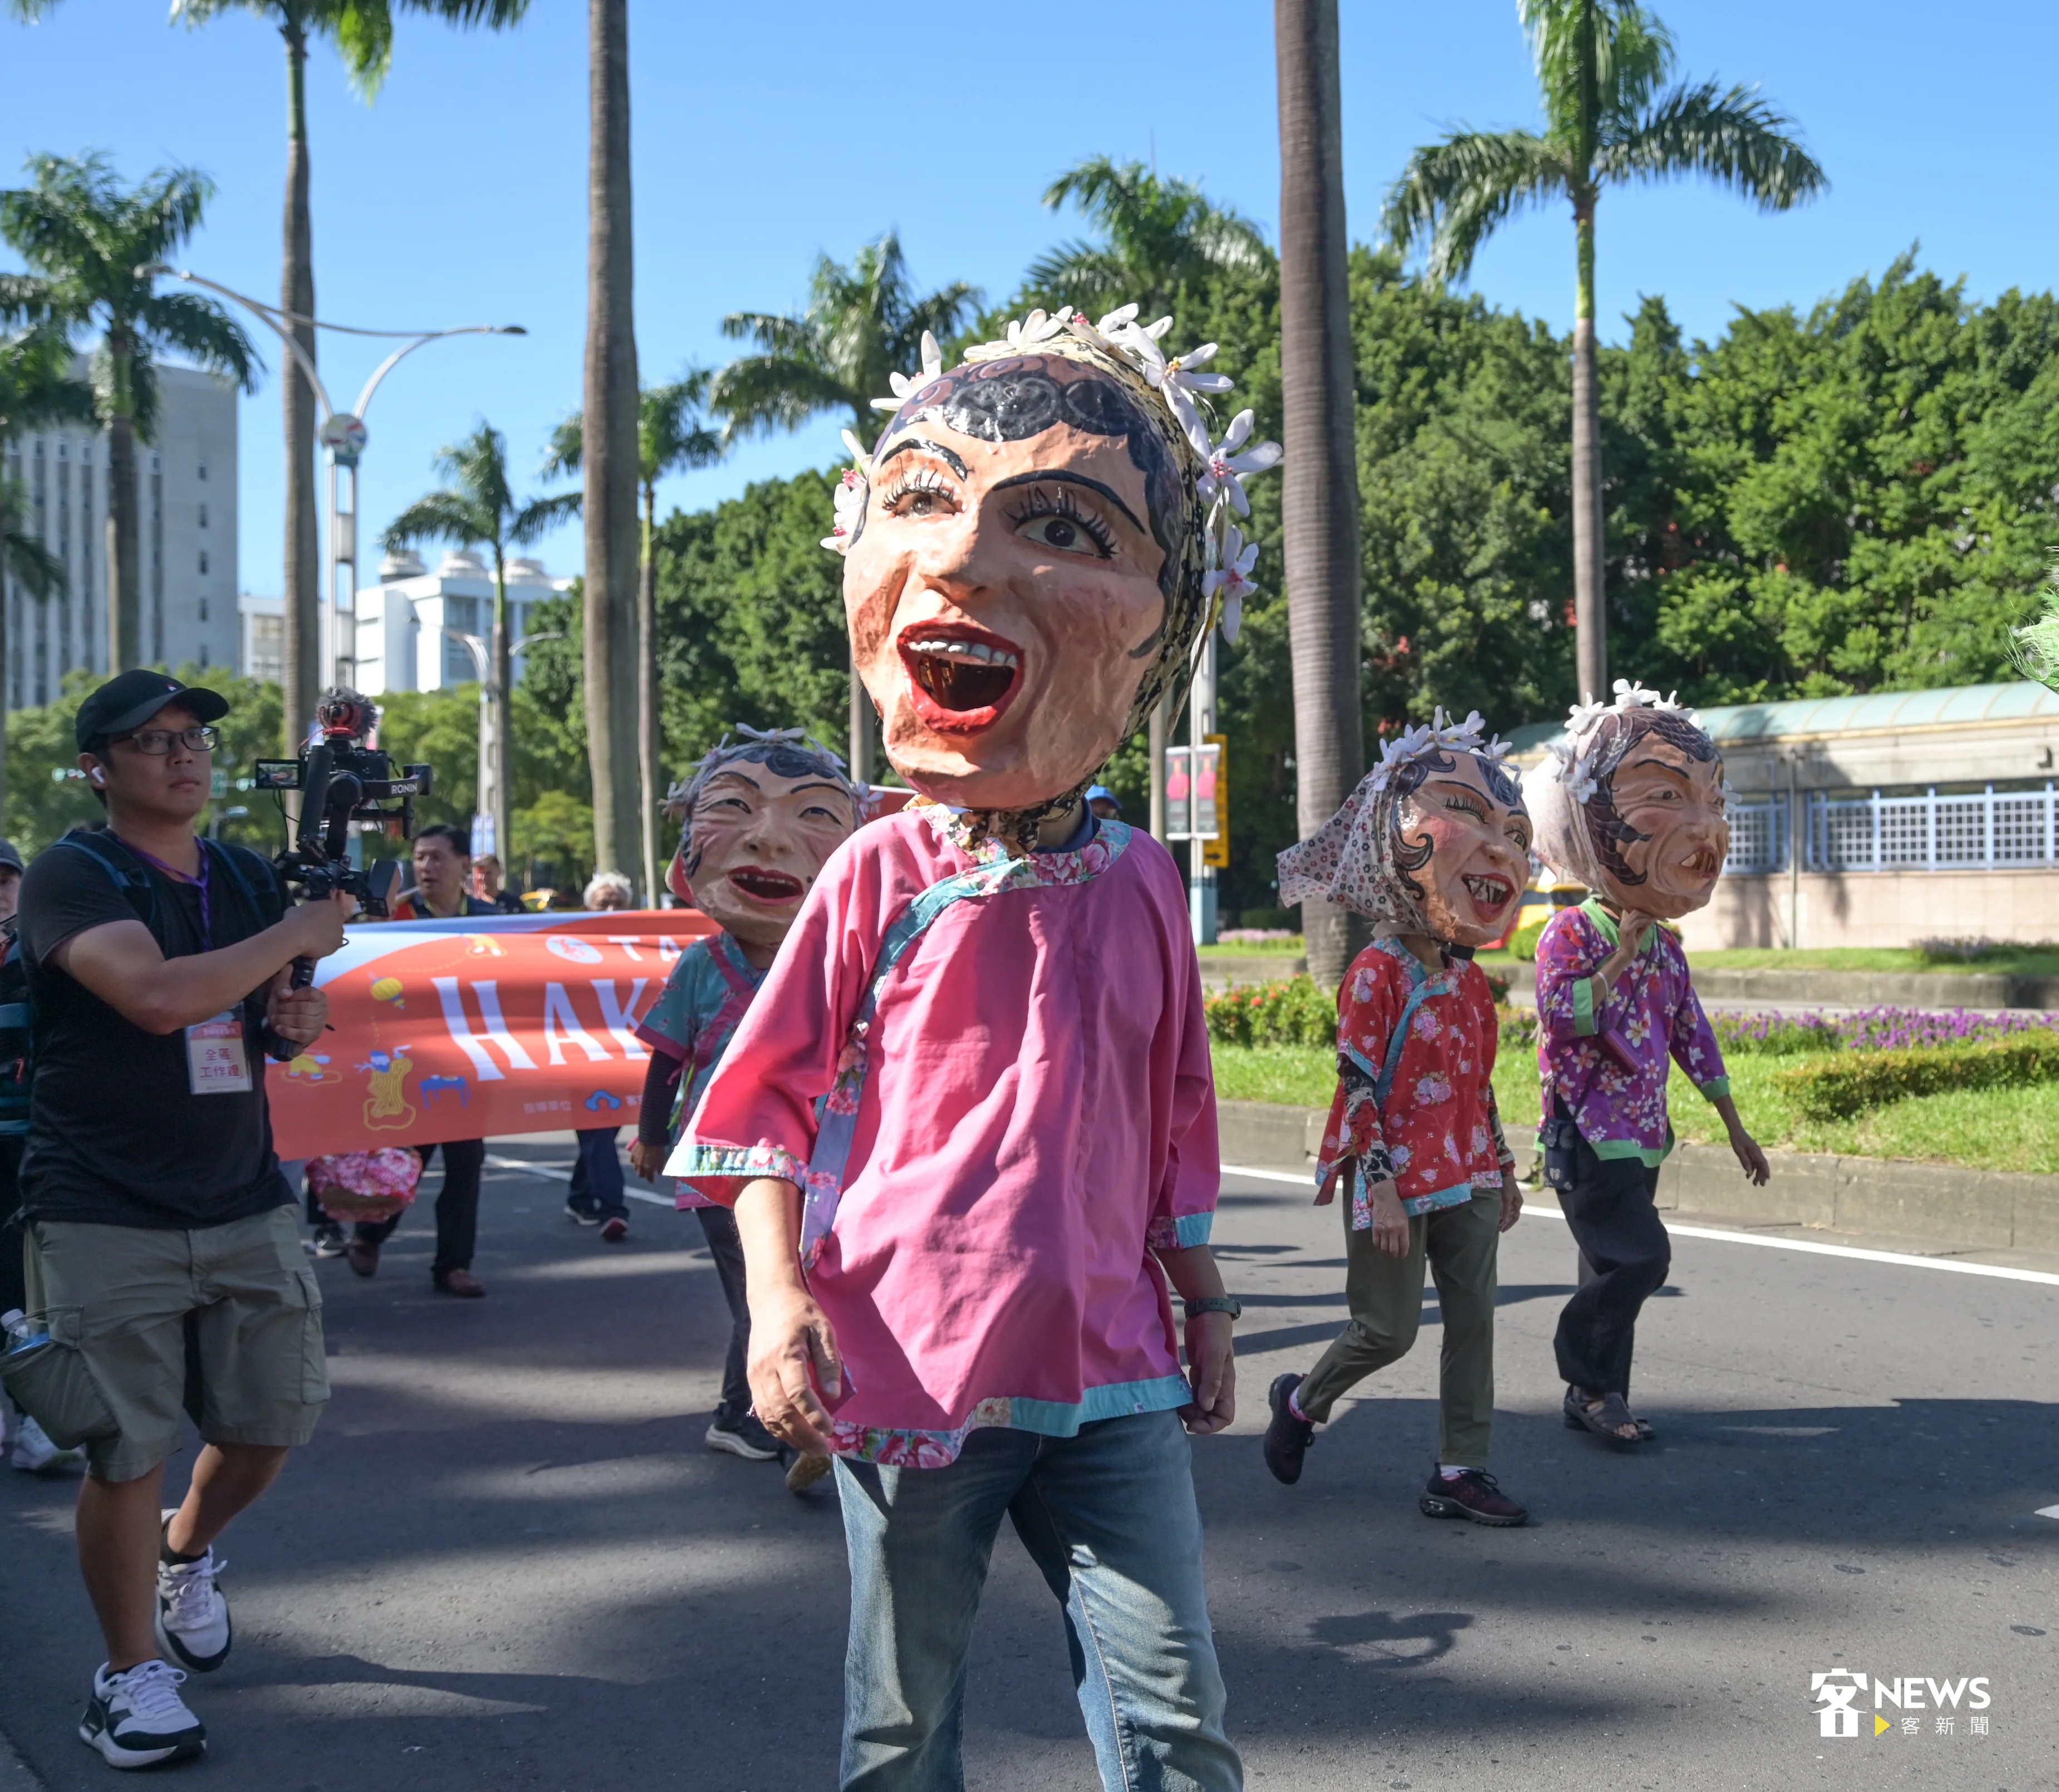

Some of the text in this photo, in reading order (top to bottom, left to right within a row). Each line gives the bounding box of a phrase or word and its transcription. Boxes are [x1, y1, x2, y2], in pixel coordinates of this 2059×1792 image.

[391, 783, 418, 794] RONIN
[607, 936, 705, 962] TA
[430, 976, 668, 1081] HAK
